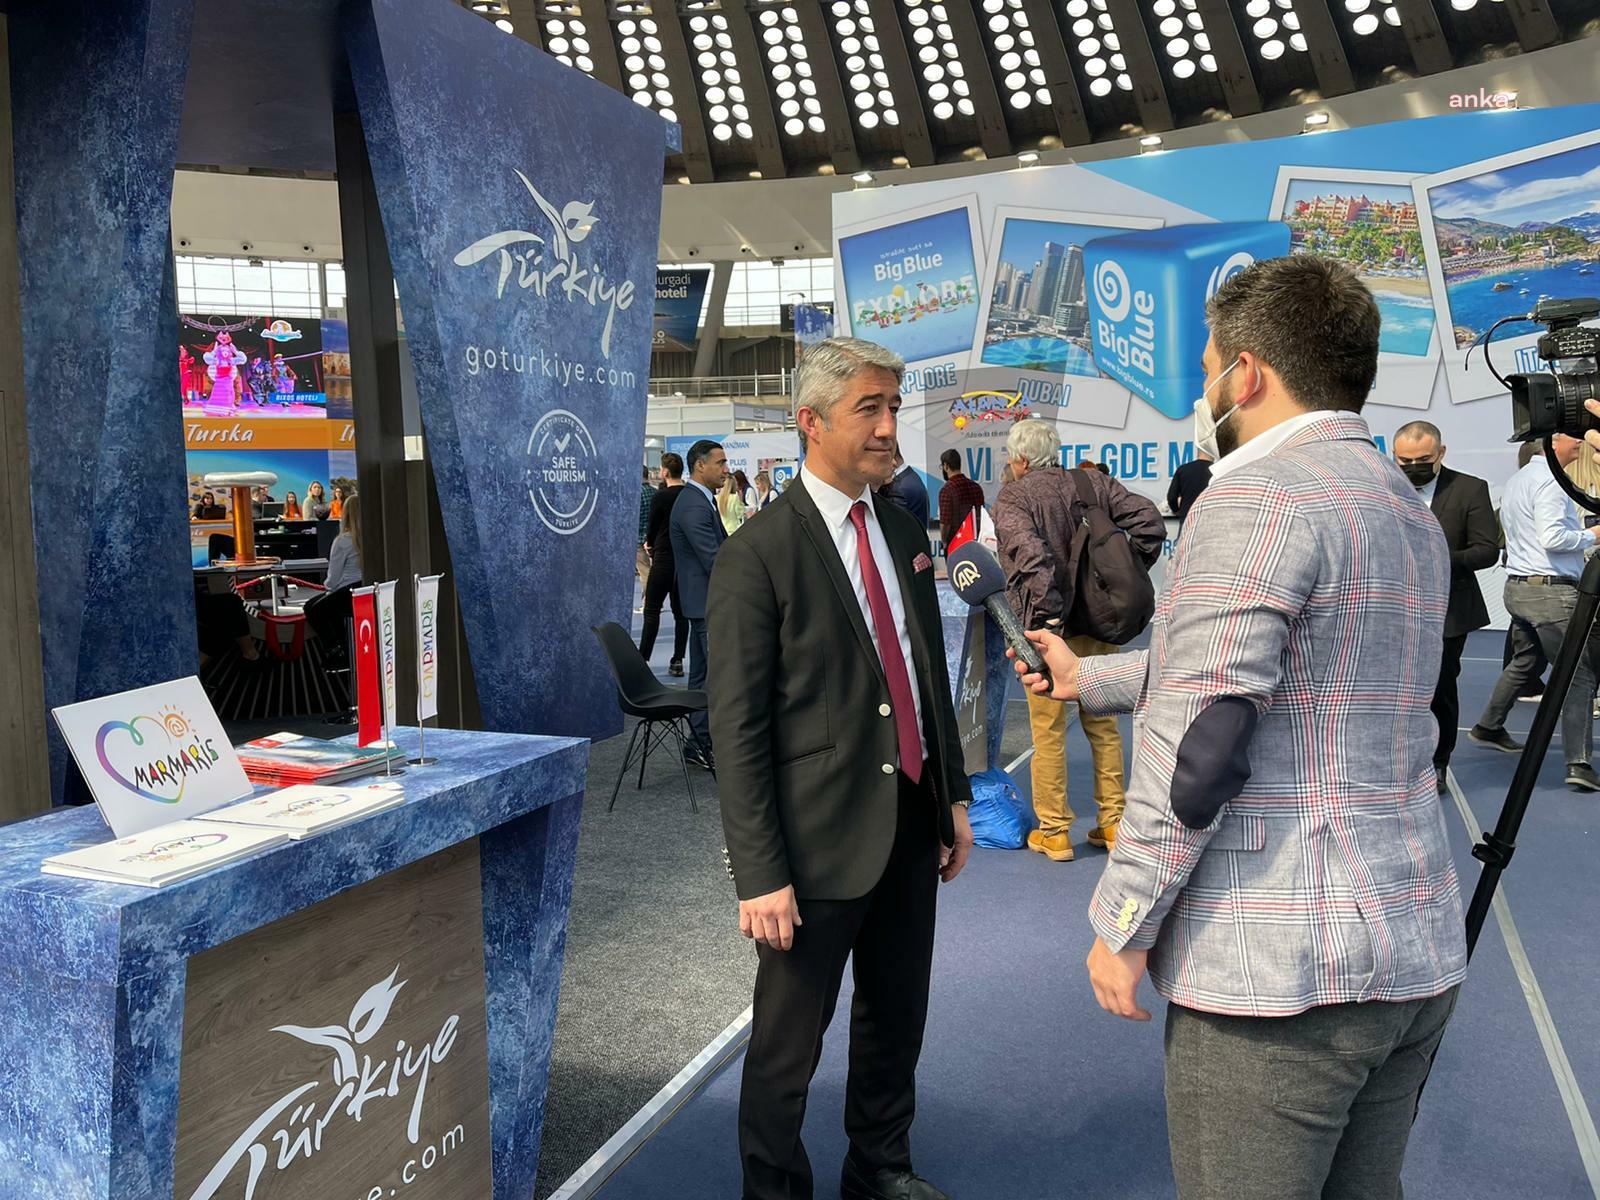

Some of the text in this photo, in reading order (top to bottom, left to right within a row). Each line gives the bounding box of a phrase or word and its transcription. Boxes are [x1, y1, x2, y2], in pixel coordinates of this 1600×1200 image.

[655, 273, 691, 287] urgadi
[465, 345, 636, 389] goturkiye.com
[1017, 377, 1073, 408] DUBAI
[186, 422, 254, 442] Turska
[551, 456, 577, 469] SAFE
[1100, 442, 1158, 480] GDE
[542, 469, 586, 482] TOURISM
